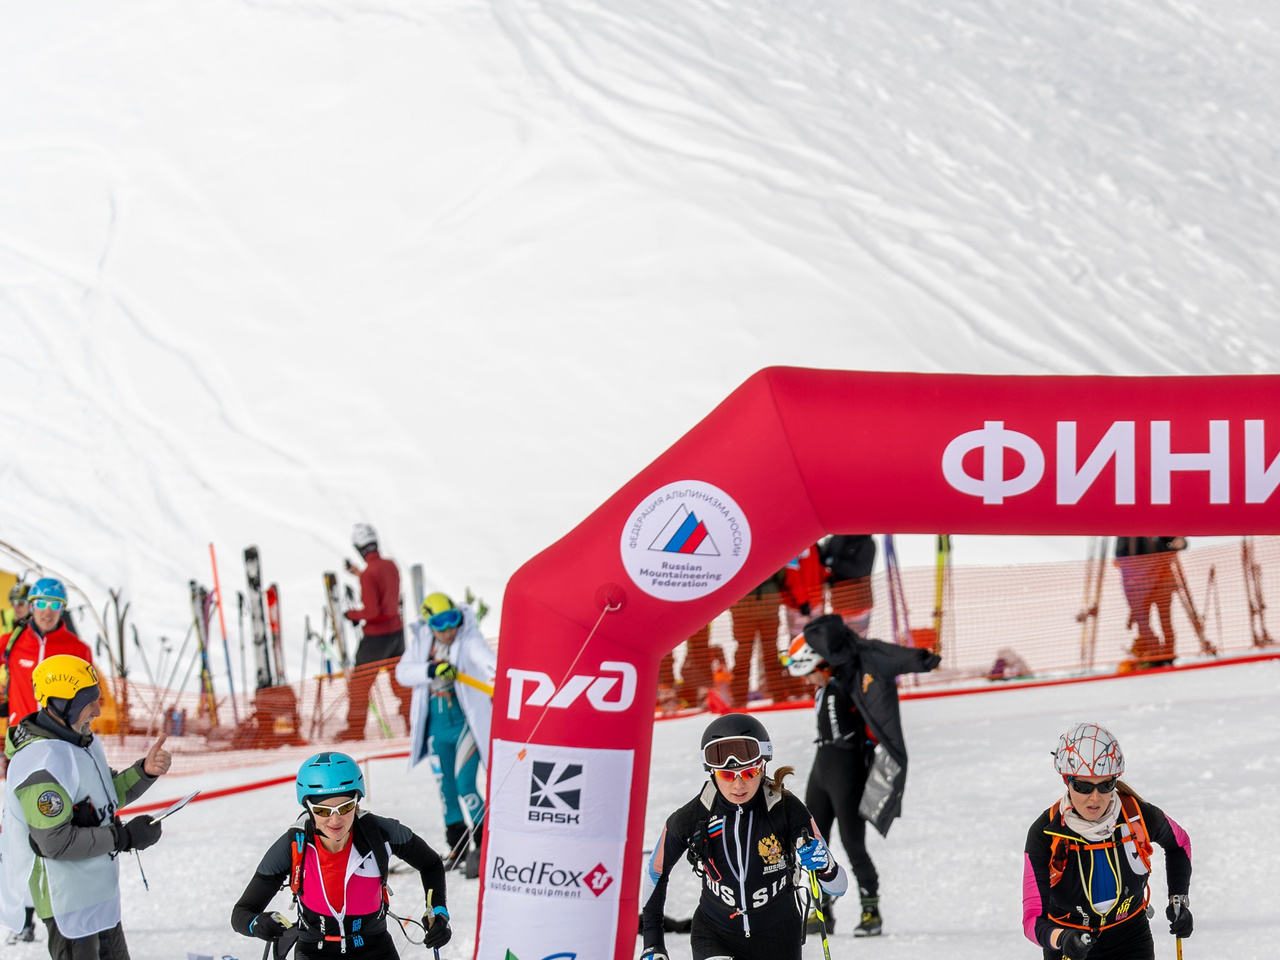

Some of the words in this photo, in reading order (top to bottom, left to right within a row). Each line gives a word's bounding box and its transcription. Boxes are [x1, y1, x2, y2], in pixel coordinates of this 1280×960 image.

[629, 497, 665, 549] ФЕДЕРАЦИЯ
[665, 489, 729, 518] АЛЬПИНИЗМА
[727, 517, 744, 557] РОССИИ
[661, 561, 702, 572] Russian
[639, 568, 722, 582] Mountaineering
[651, 578, 708, 588] Federation
[45, 674, 80, 688] GRIVEL
[528, 811, 580, 825] BASK
[491, 882, 521, 893] outdoor
[525, 887, 582, 898] equipment
